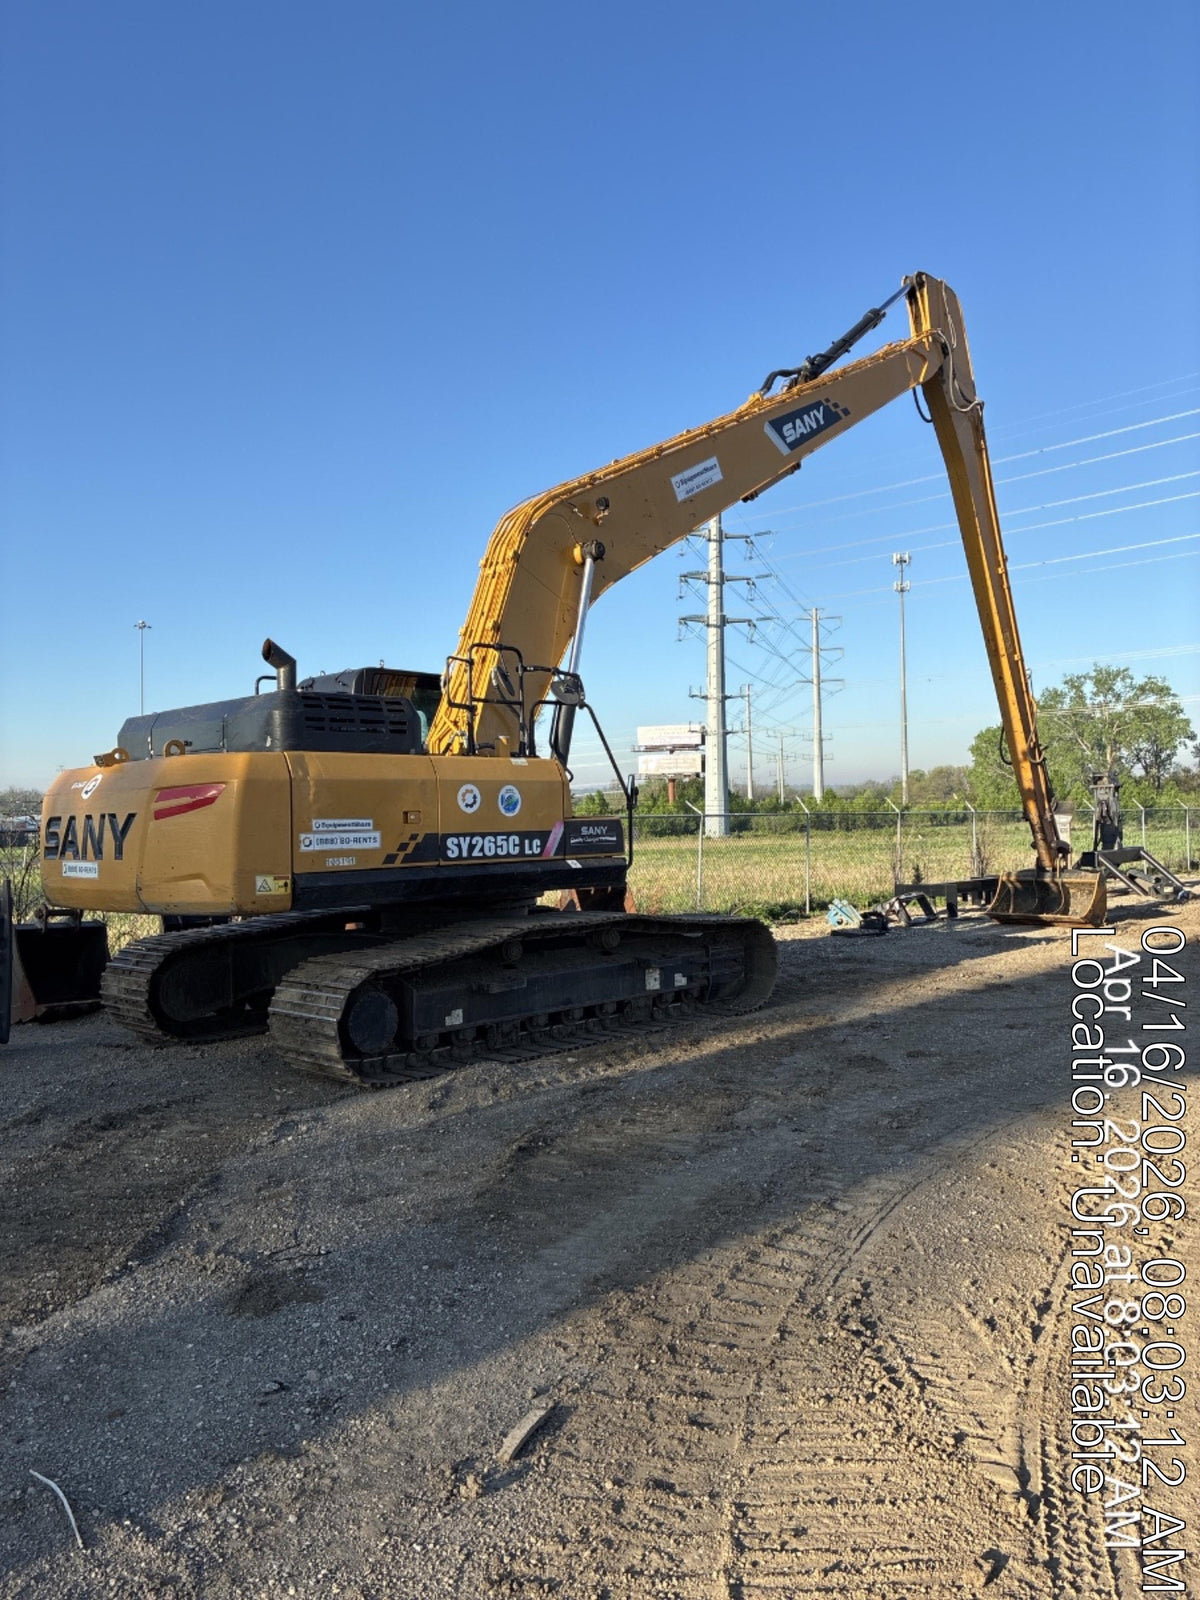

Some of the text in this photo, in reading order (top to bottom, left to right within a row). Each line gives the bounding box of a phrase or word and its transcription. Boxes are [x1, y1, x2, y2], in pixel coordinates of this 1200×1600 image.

[782, 405, 824, 444] SANY
[44, 812, 137, 860] SANY
[446, 835, 541, 858] SY265C LC
[581, 826, 608, 836] SANY
